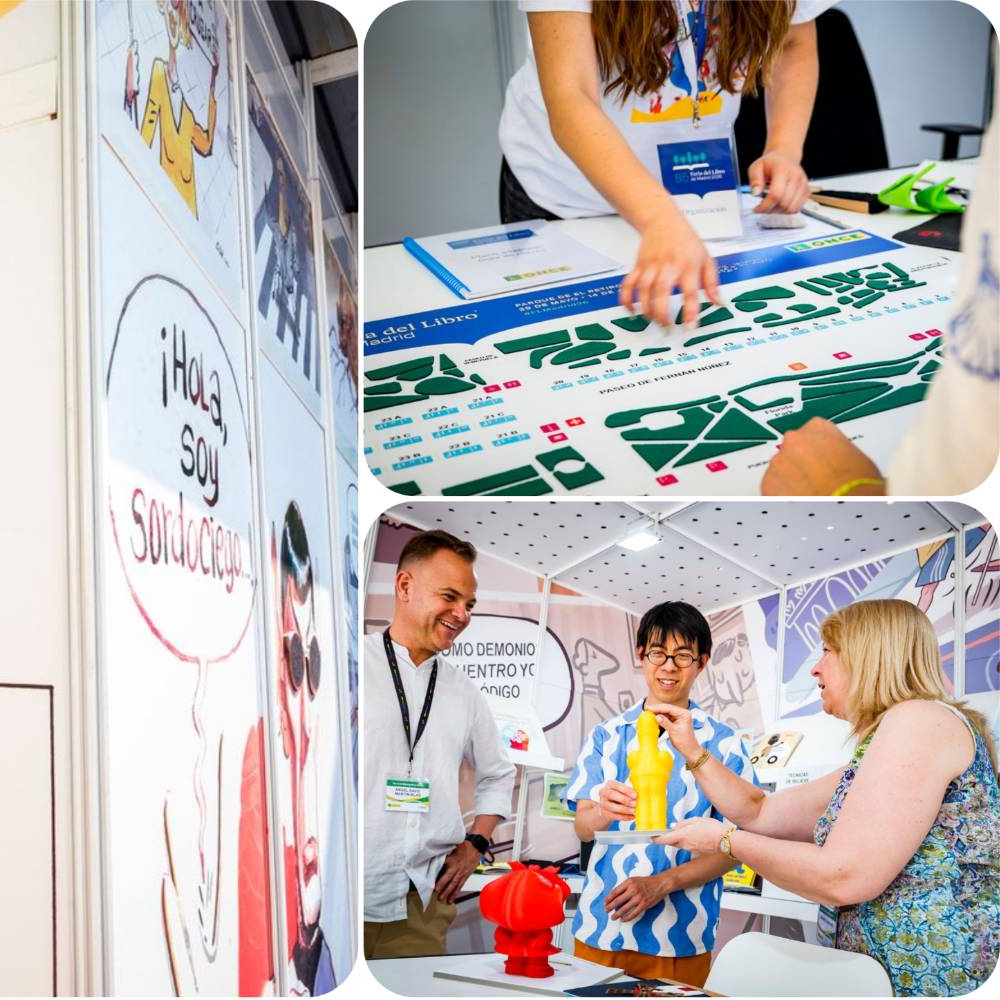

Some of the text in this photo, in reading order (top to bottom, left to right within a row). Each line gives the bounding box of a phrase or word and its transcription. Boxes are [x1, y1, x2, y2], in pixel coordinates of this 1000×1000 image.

[812, 231, 864, 248] ONCE
[382, 322, 416, 336] del
[421, 313, 478, 329] Libro
[599, 383, 636, 394] PASEO
[476, 642, 536, 656] DEMONIO
